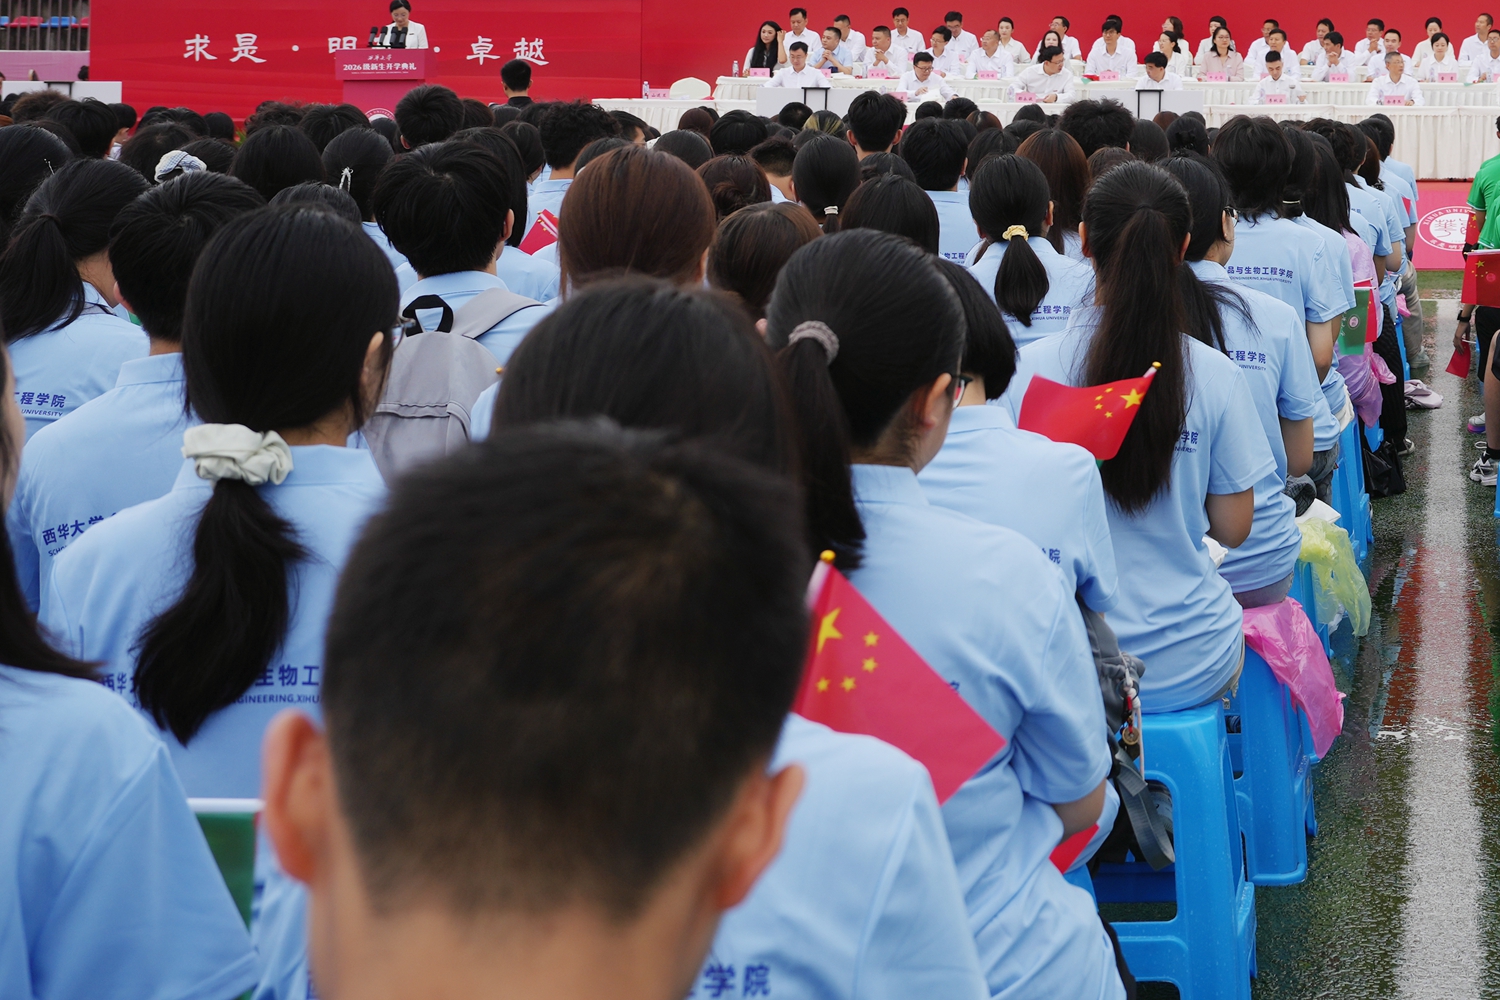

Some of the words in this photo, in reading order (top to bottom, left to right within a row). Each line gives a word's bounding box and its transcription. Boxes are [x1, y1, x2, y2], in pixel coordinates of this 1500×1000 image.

[1227, 265, 1294, 279] 品与生物工程学院
[1042, 548, 1061, 564] 院
